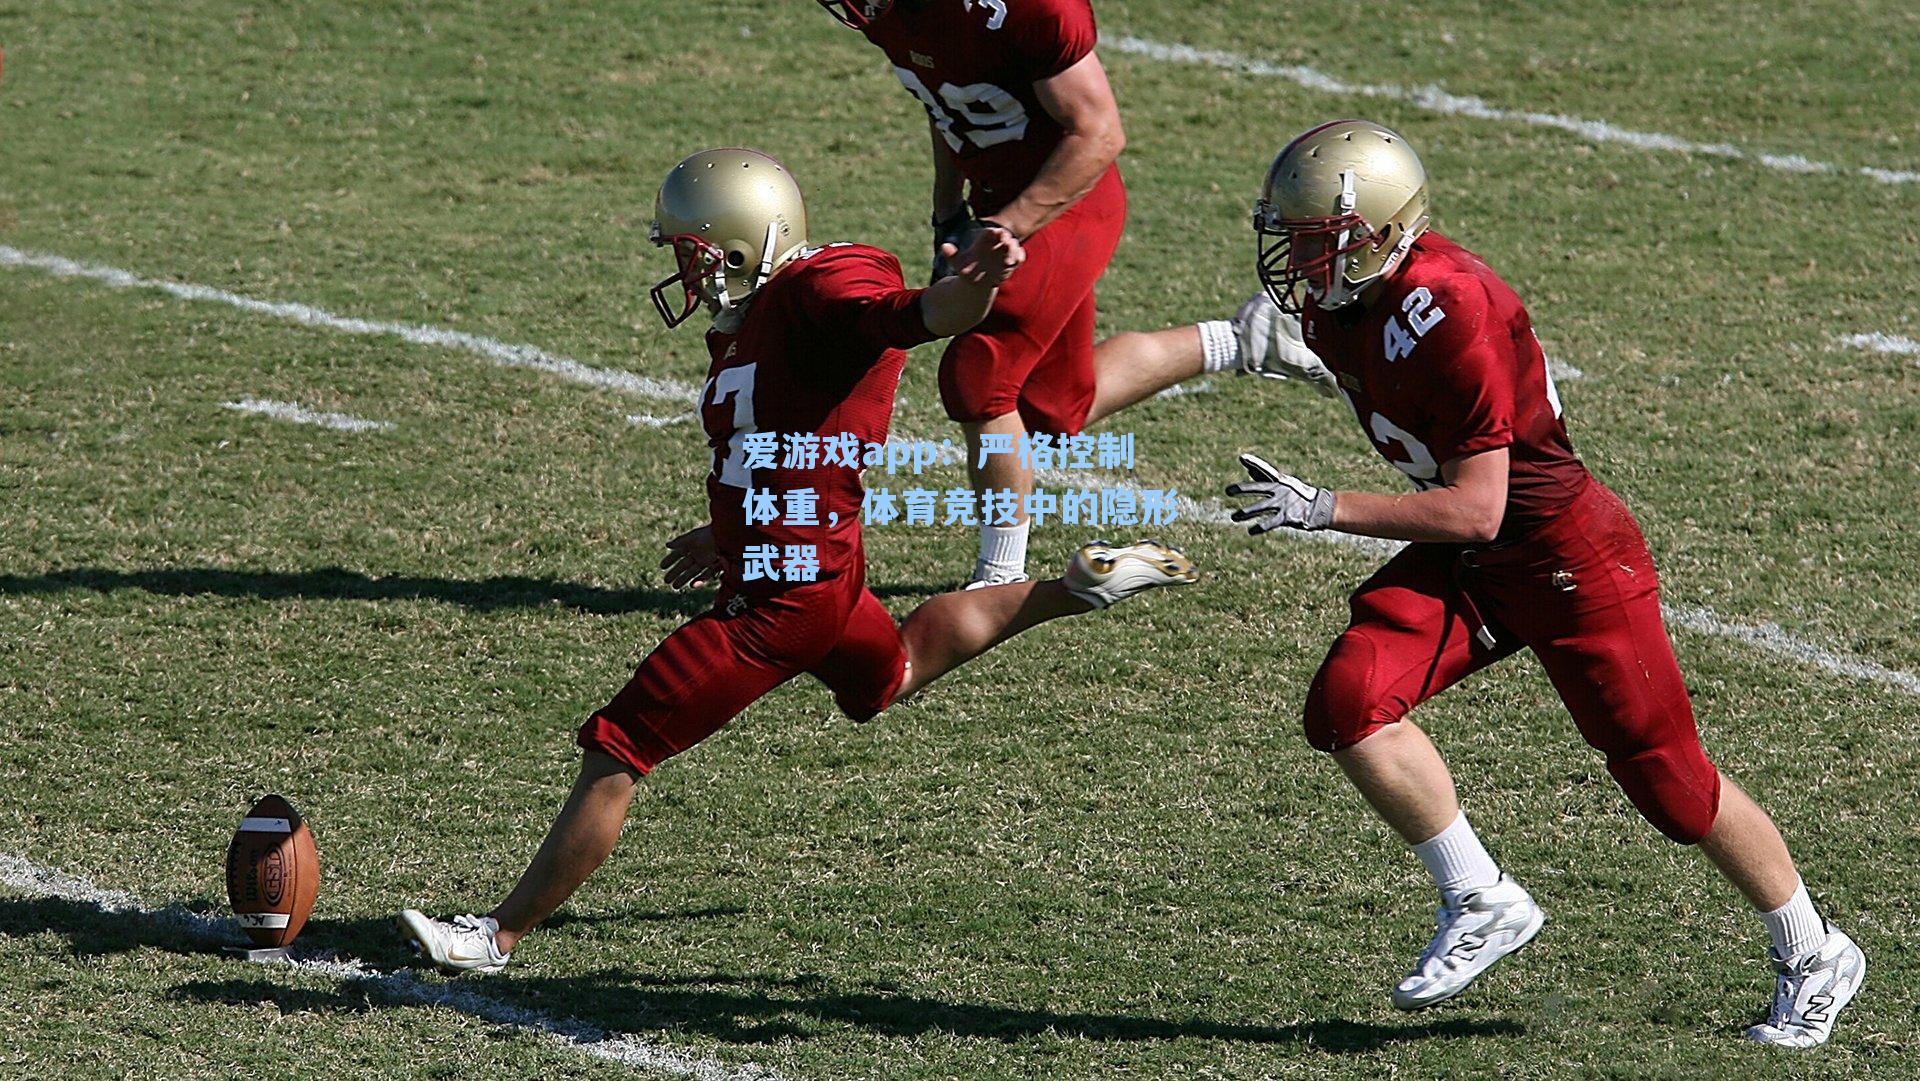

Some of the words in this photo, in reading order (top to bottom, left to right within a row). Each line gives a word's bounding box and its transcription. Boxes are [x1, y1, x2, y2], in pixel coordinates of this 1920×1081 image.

[1383, 286, 1446, 363] 42
[698, 362, 760, 490] 7
[1445, 932, 1487, 962] N
[1802, 994, 1835, 1022] N
